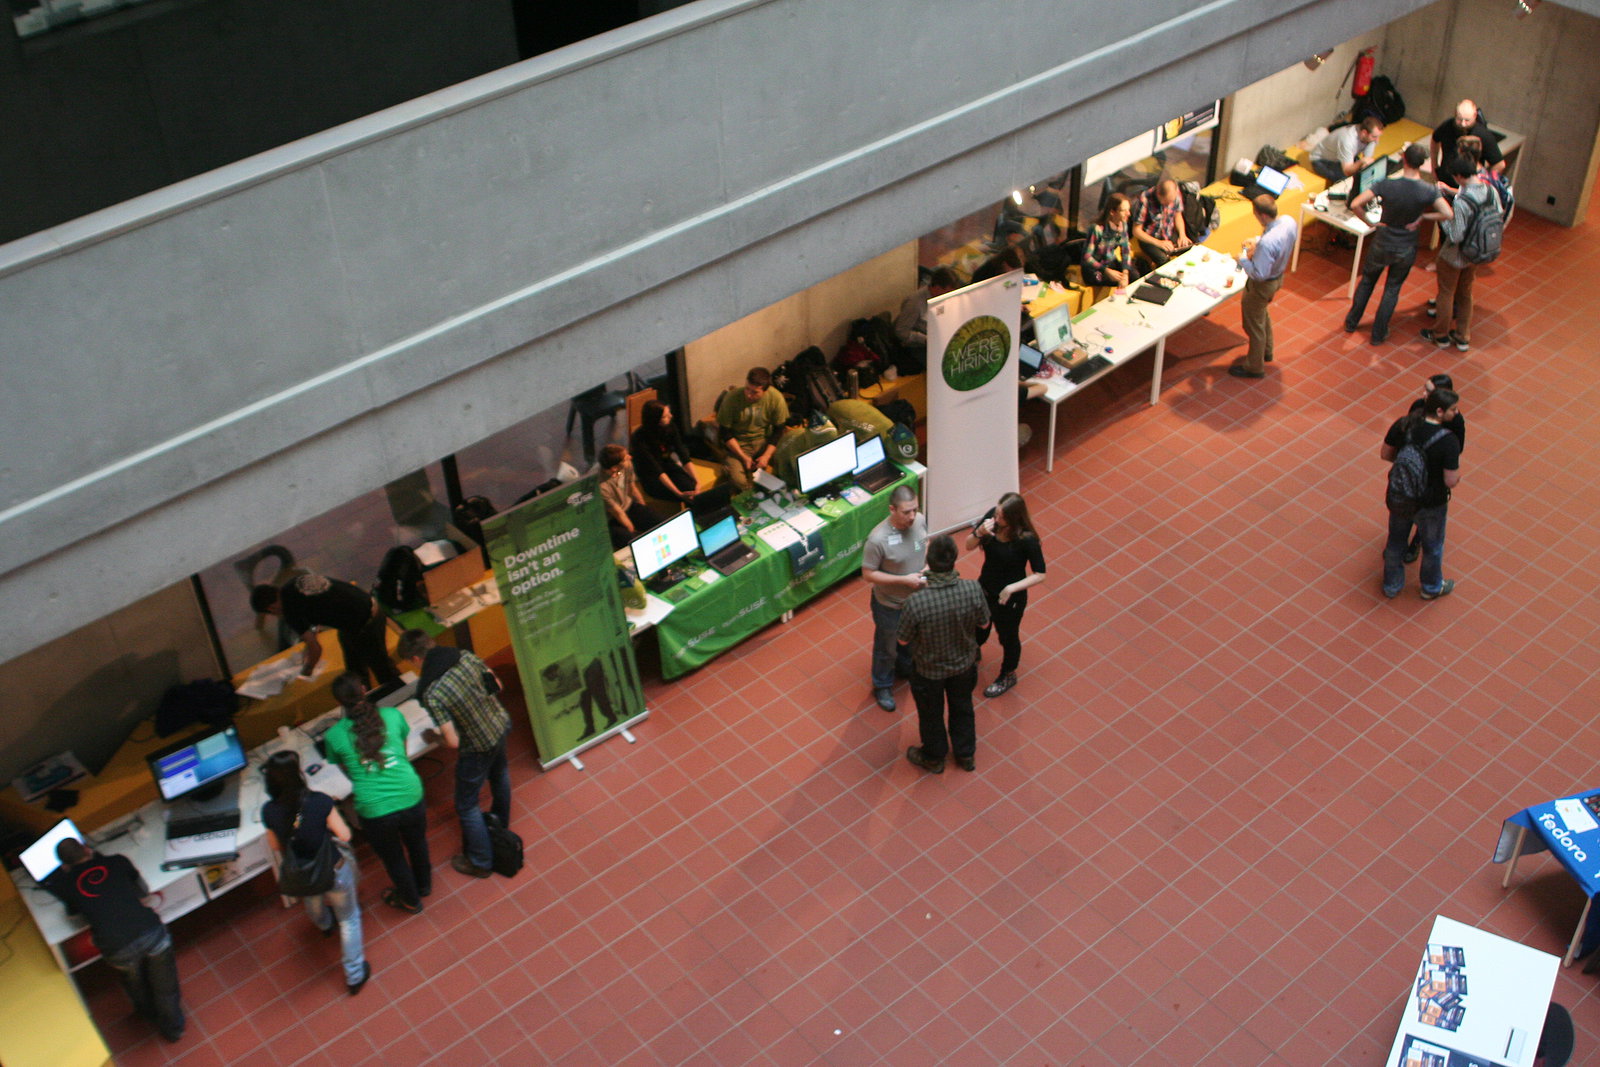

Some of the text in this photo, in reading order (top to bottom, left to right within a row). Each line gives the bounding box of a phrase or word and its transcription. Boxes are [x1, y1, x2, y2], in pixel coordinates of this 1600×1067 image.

[950, 349, 1001, 377] HIRING
[504, 527, 580, 569] Downtime
[507, 551, 561, 582] isn't an
[511, 566, 564, 596] option.
[1539, 812, 1587, 863] fedora
